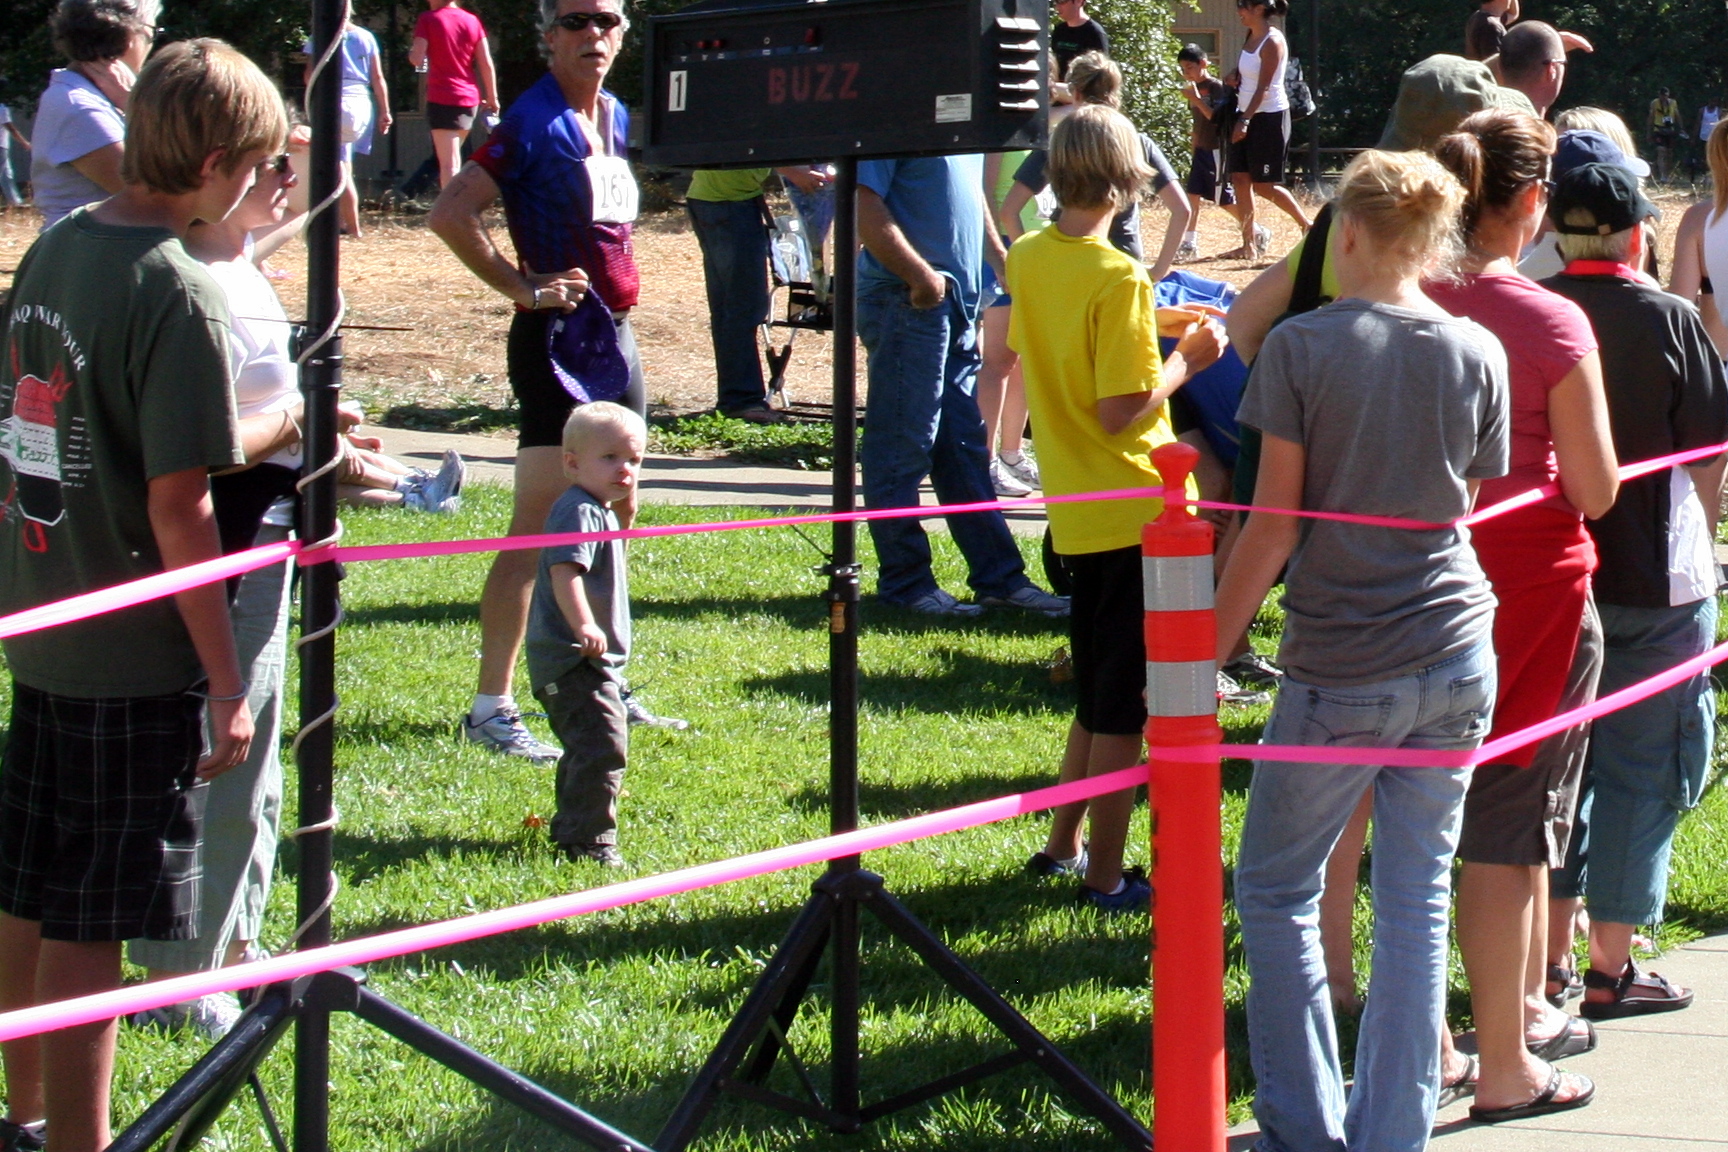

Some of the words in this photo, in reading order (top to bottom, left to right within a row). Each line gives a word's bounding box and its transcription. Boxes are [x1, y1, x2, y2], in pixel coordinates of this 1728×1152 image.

[673, 74, 684, 110] 1
[768, 62, 860, 104] BUZZ
[600, 173, 630, 209] 167
[35, 304, 61, 330] WAR
